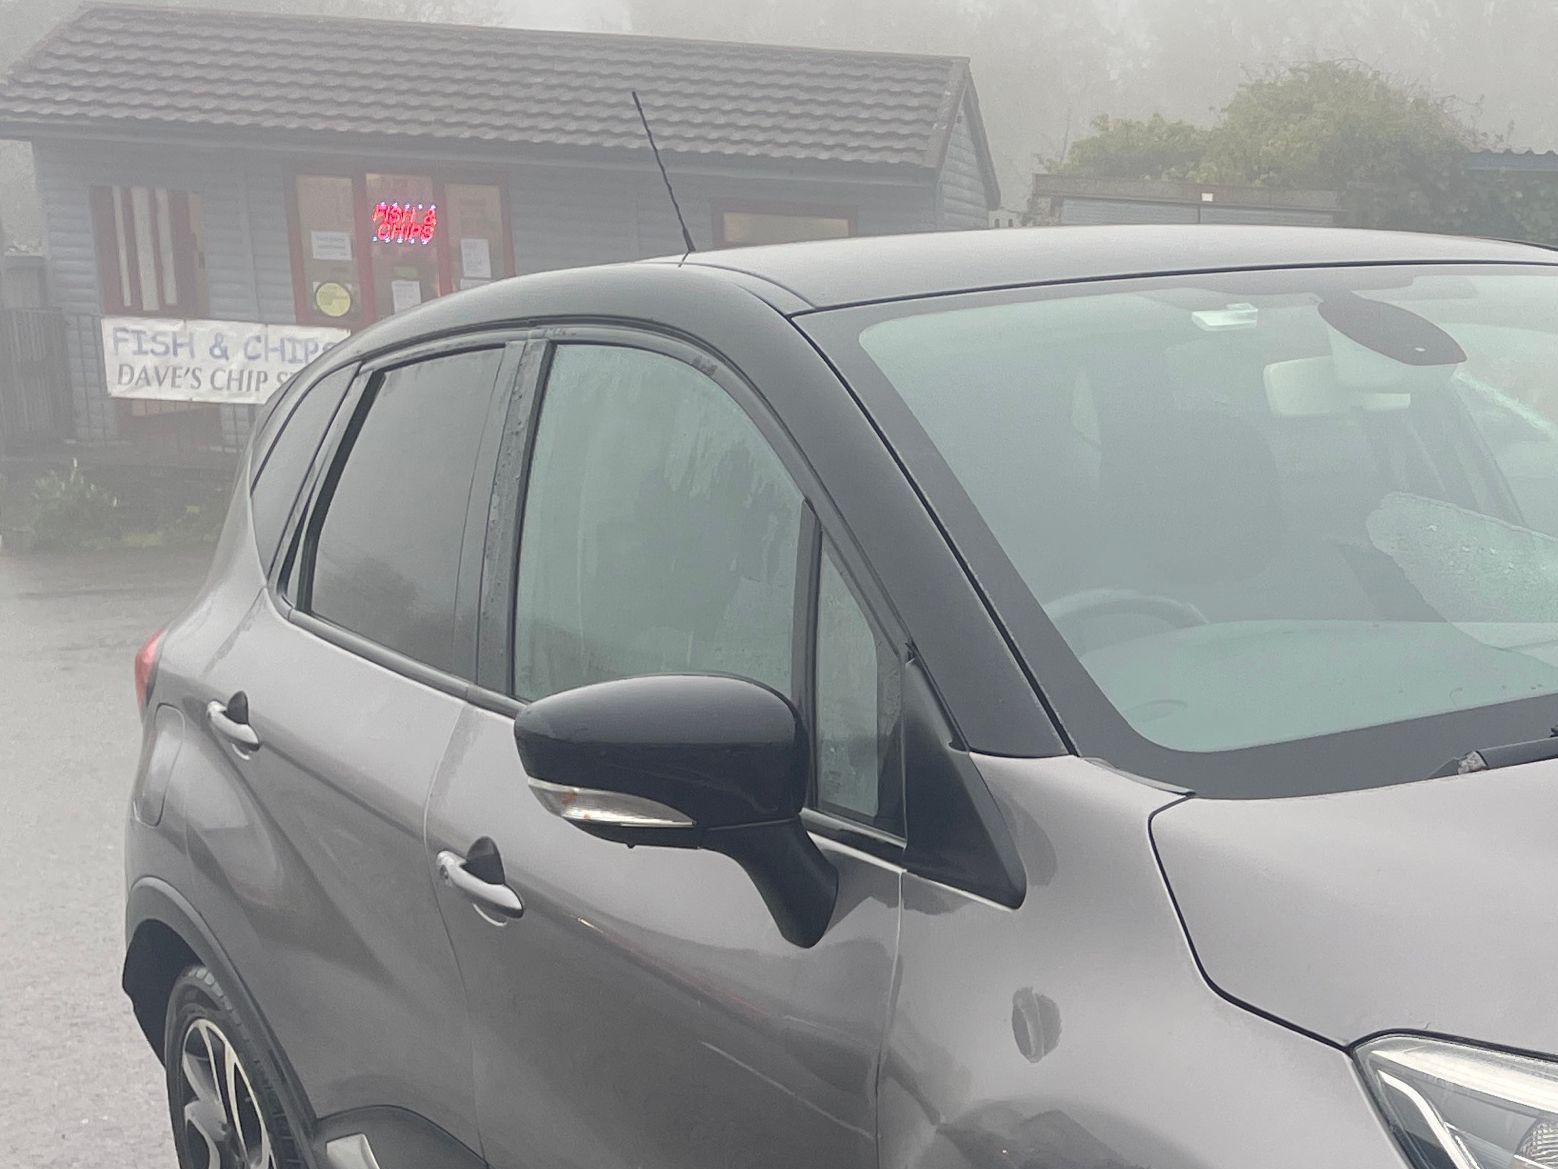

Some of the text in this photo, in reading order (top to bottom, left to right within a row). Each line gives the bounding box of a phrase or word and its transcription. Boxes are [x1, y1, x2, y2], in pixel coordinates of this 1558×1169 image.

[373, 204, 436, 225] FISH &
[377, 222, 434, 242] CHIPS
[112, 326, 195, 360] FISH
[208, 331, 230, 362] &
[117, 362, 203, 391] DAVE'S
[209, 366, 269, 393] CHIP
